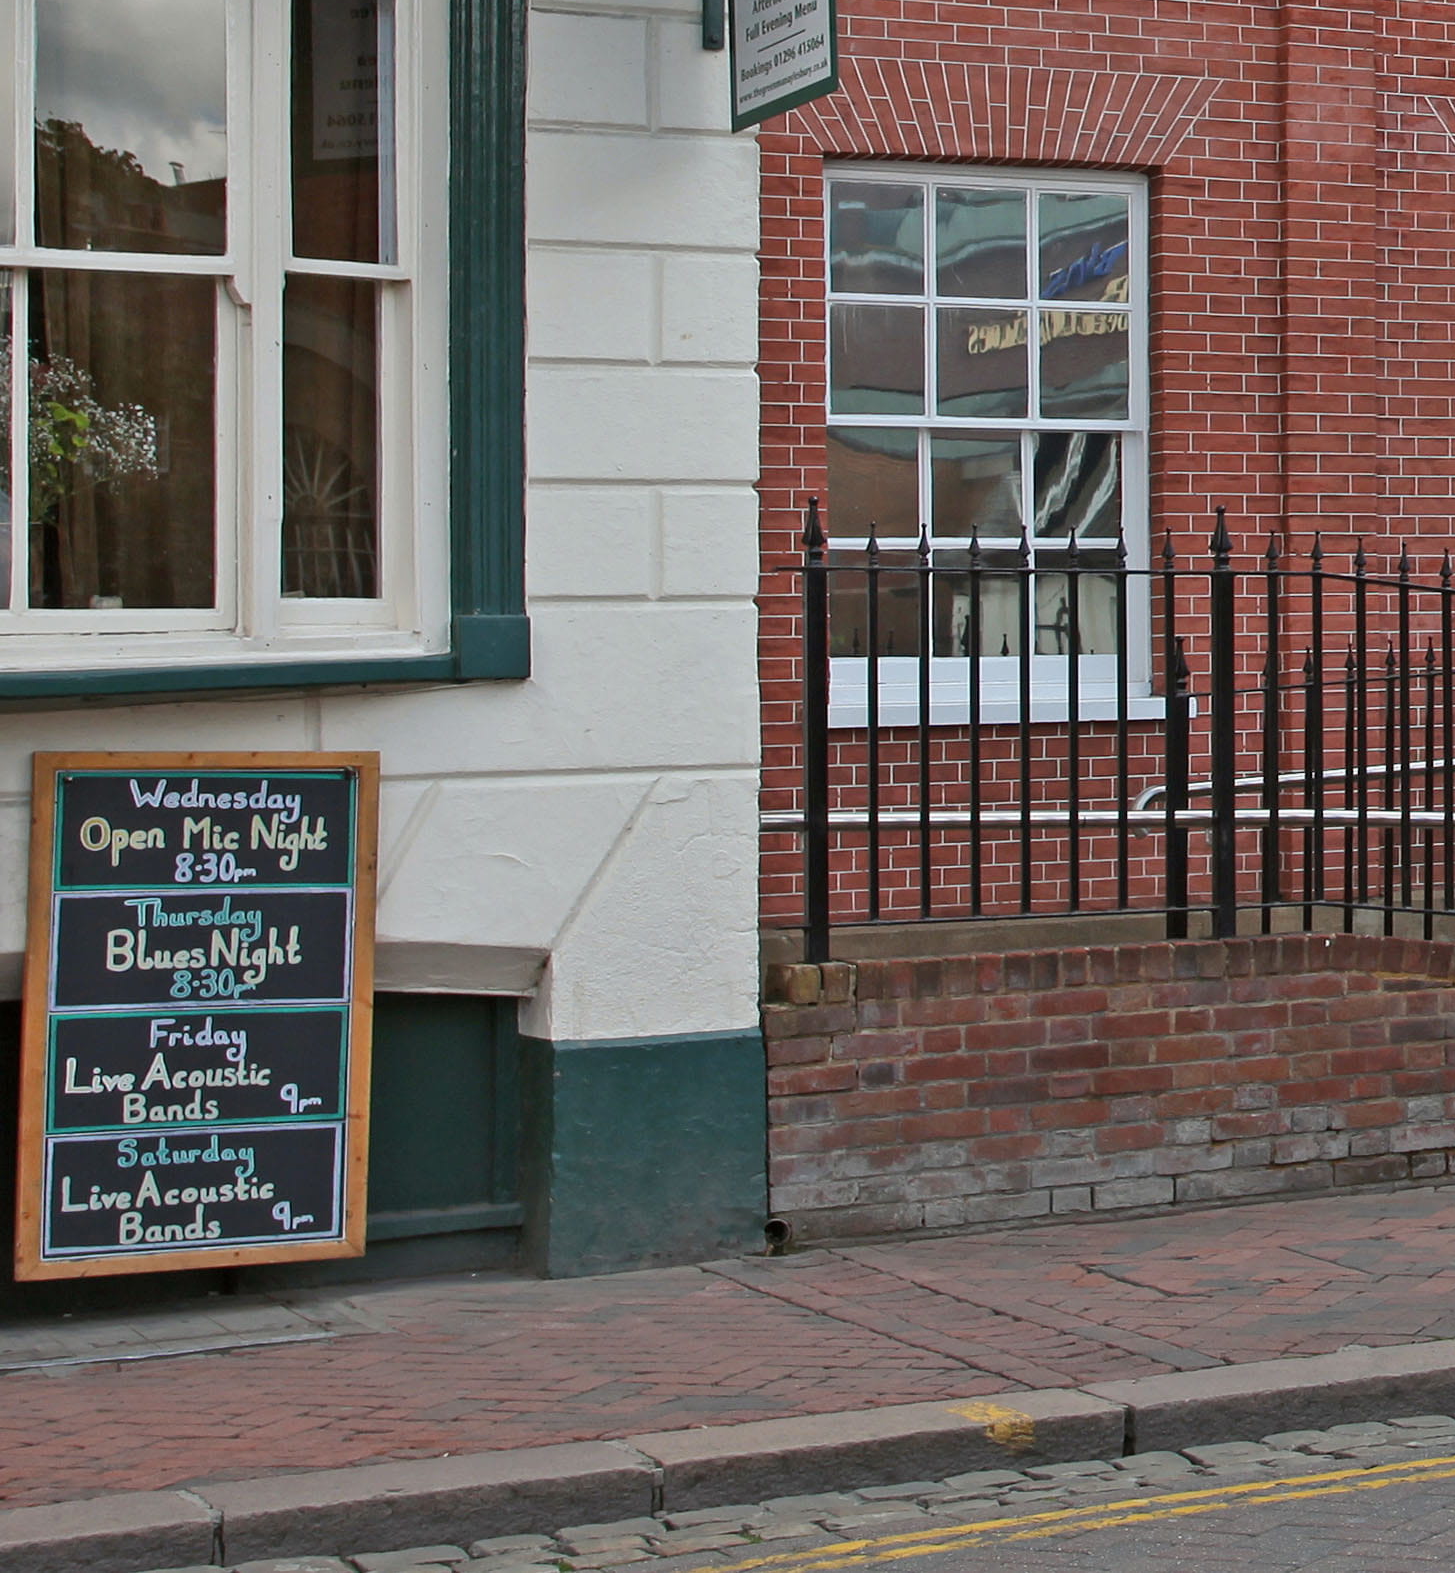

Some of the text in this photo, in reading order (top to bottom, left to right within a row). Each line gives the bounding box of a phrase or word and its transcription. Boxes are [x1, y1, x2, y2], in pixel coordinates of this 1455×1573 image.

[746, 0, 817, 42] Full Evening Menu
[741, 60, 772, 82] Bookings
[129, 778, 300, 824] Wednesday
[80, 814, 328, 871] Open Mic Night
[124, 896, 262, 942] Thursday
[106, 925, 302, 985] Blues Night
[150, 1016, 246, 1062] Friday
[64, 1052, 271, 1094] Live Acoustic
[123, 1083, 322, 1124] Bands 9pm
[117, 1134, 255, 1177] Saturday
[61, 1170, 275, 1212] Live Acoustic
[119, 1201, 314, 1245] Bands 9pm
